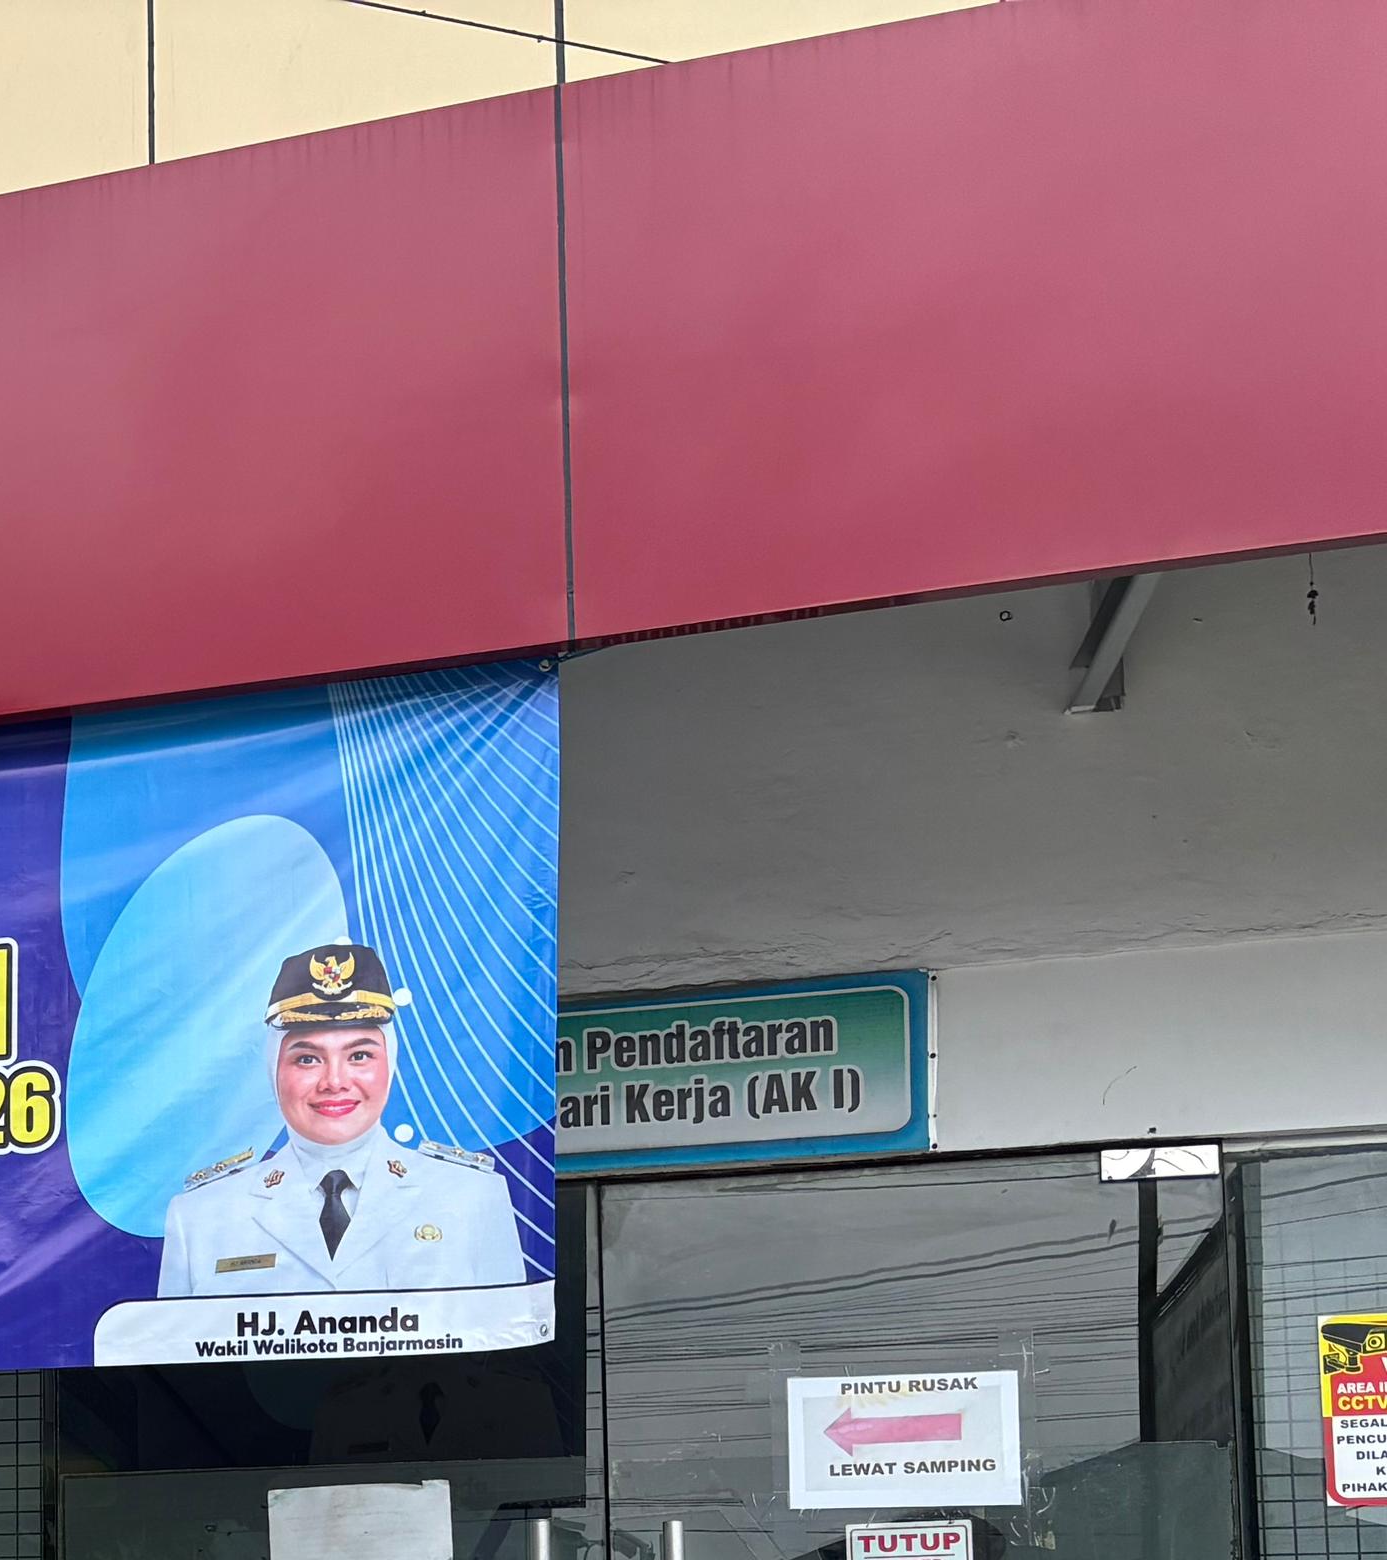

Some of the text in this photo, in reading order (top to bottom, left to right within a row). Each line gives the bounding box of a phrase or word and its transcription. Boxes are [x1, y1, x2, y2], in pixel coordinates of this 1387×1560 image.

[586, 1018, 834, 1071] Pendaftaran
[625, 1078, 731, 1125] Kerja
[747, 1069, 819, 1120] (AK
[237, 1307, 419, 1337] HJ. Ananda
[196, 1334, 464, 1357] Wakil Walikota Banjarmasin
[840, 1377, 979, 1395] PINTU RUSAK
[1337, 1382, 1376, 1394] AREA
[829, 1459, 997, 1477] LEWAT SAMPING
[858, 1532, 961, 1553] TUTUP
